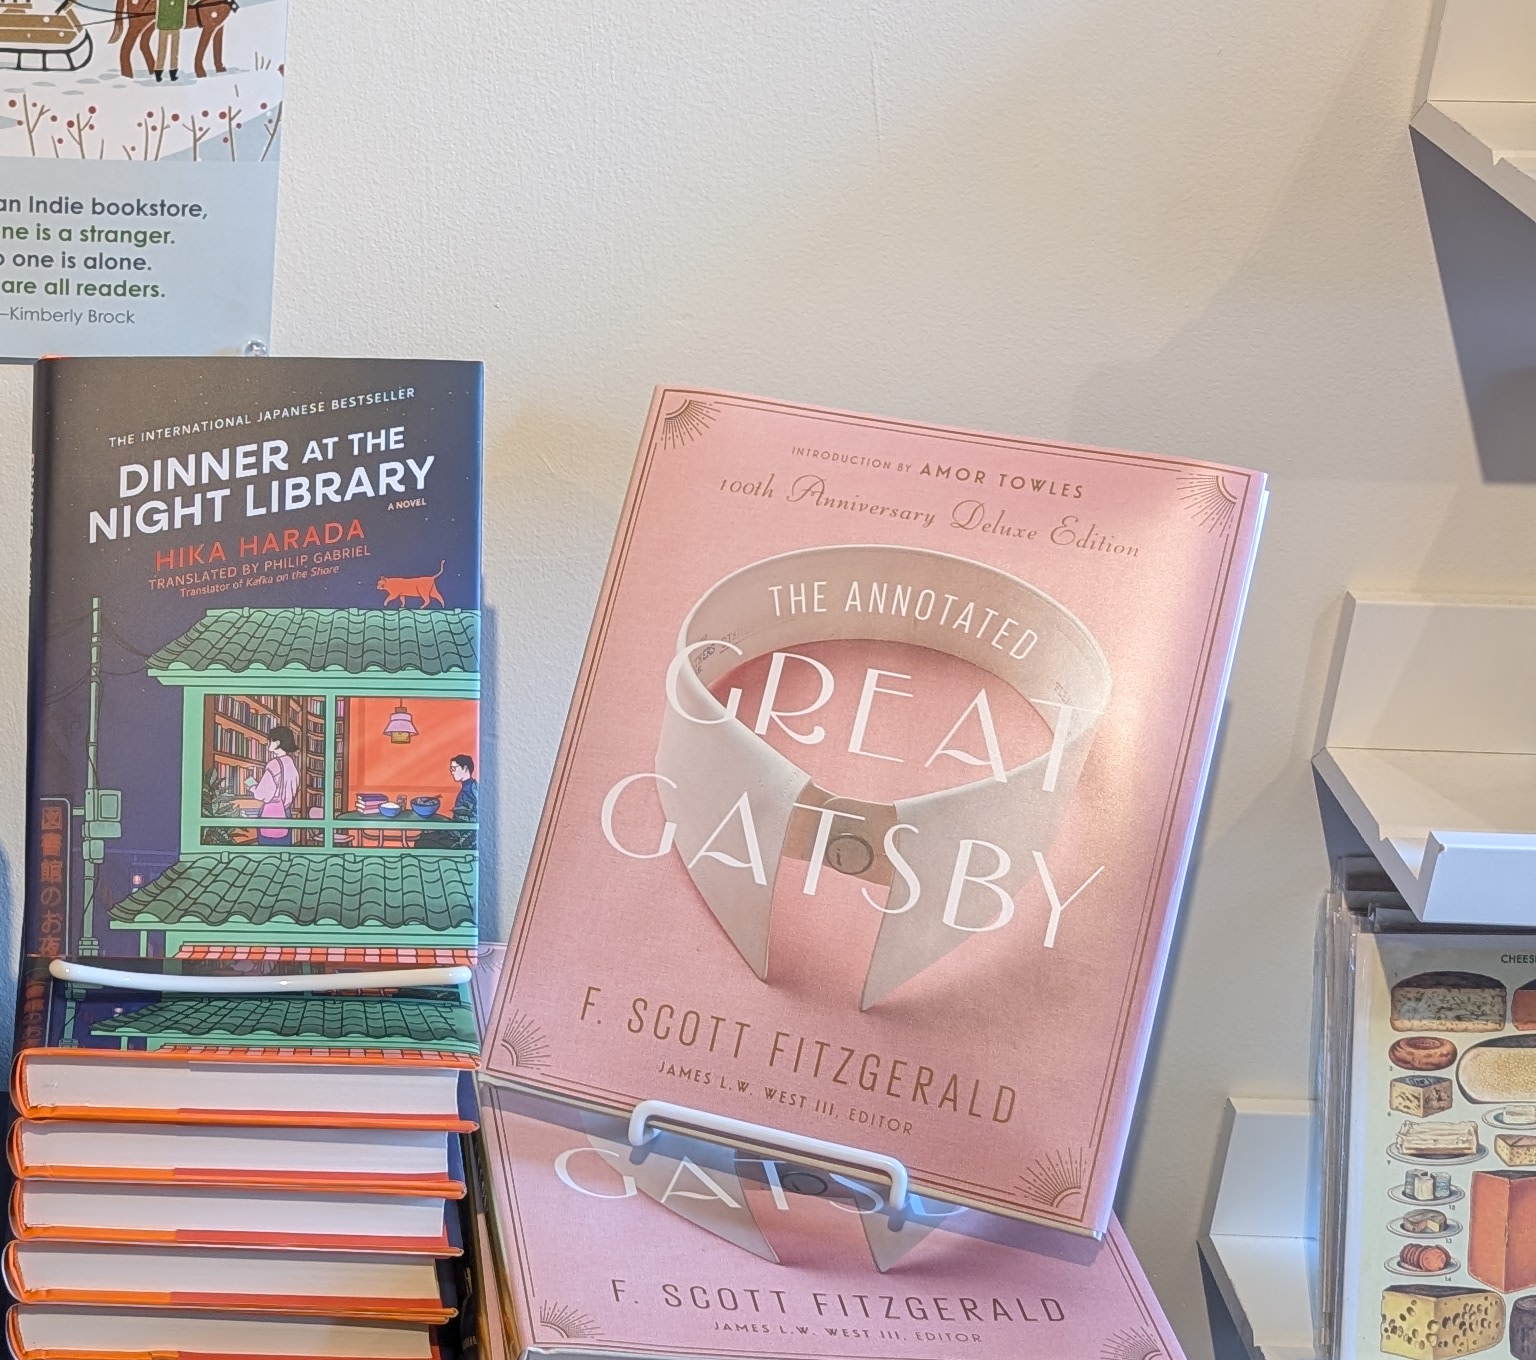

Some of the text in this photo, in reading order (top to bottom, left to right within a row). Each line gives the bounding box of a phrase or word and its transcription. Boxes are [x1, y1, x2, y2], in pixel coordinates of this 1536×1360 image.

[29, 196, 83, 215] Indie
[91, 197, 208, 220] bookstore,
[36, 223, 51, 240] is
[58, 227, 73, 241] a
[79, 226, 176, 247] stranger.
[2, 278, 37, 294] are
[44, 278, 70, 295] all
[76, 280, 166, 298] readers.
[12, 253, 54, 268] one
[61, 252, 77, 269] is
[84, 253, 152, 270] alone.
[88, 309, 135, 324] Brock
[110, 387, 416, 447] THE INTERNATIONAL JAPANESE BESTSELLER
[119, 426, 405, 499] DINNER AT THE
[791, 446, 1084, 499] INTRODUCTION BY AMOR TOWLES
[88, 456, 435, 544] NIGHT LIBRARY
[155, 518, 365, 572] HIKA HARADA
[769, 580, 1039, 660] THE ANNOTATED
[664, 641, 1098, 792] GREAT
[600, 772, 1105, 949] GATSBY
[1501, 952, 1536, 964] CHEES
[579, 987, 1018, 1125] F. SCOTT FITZGERALD
